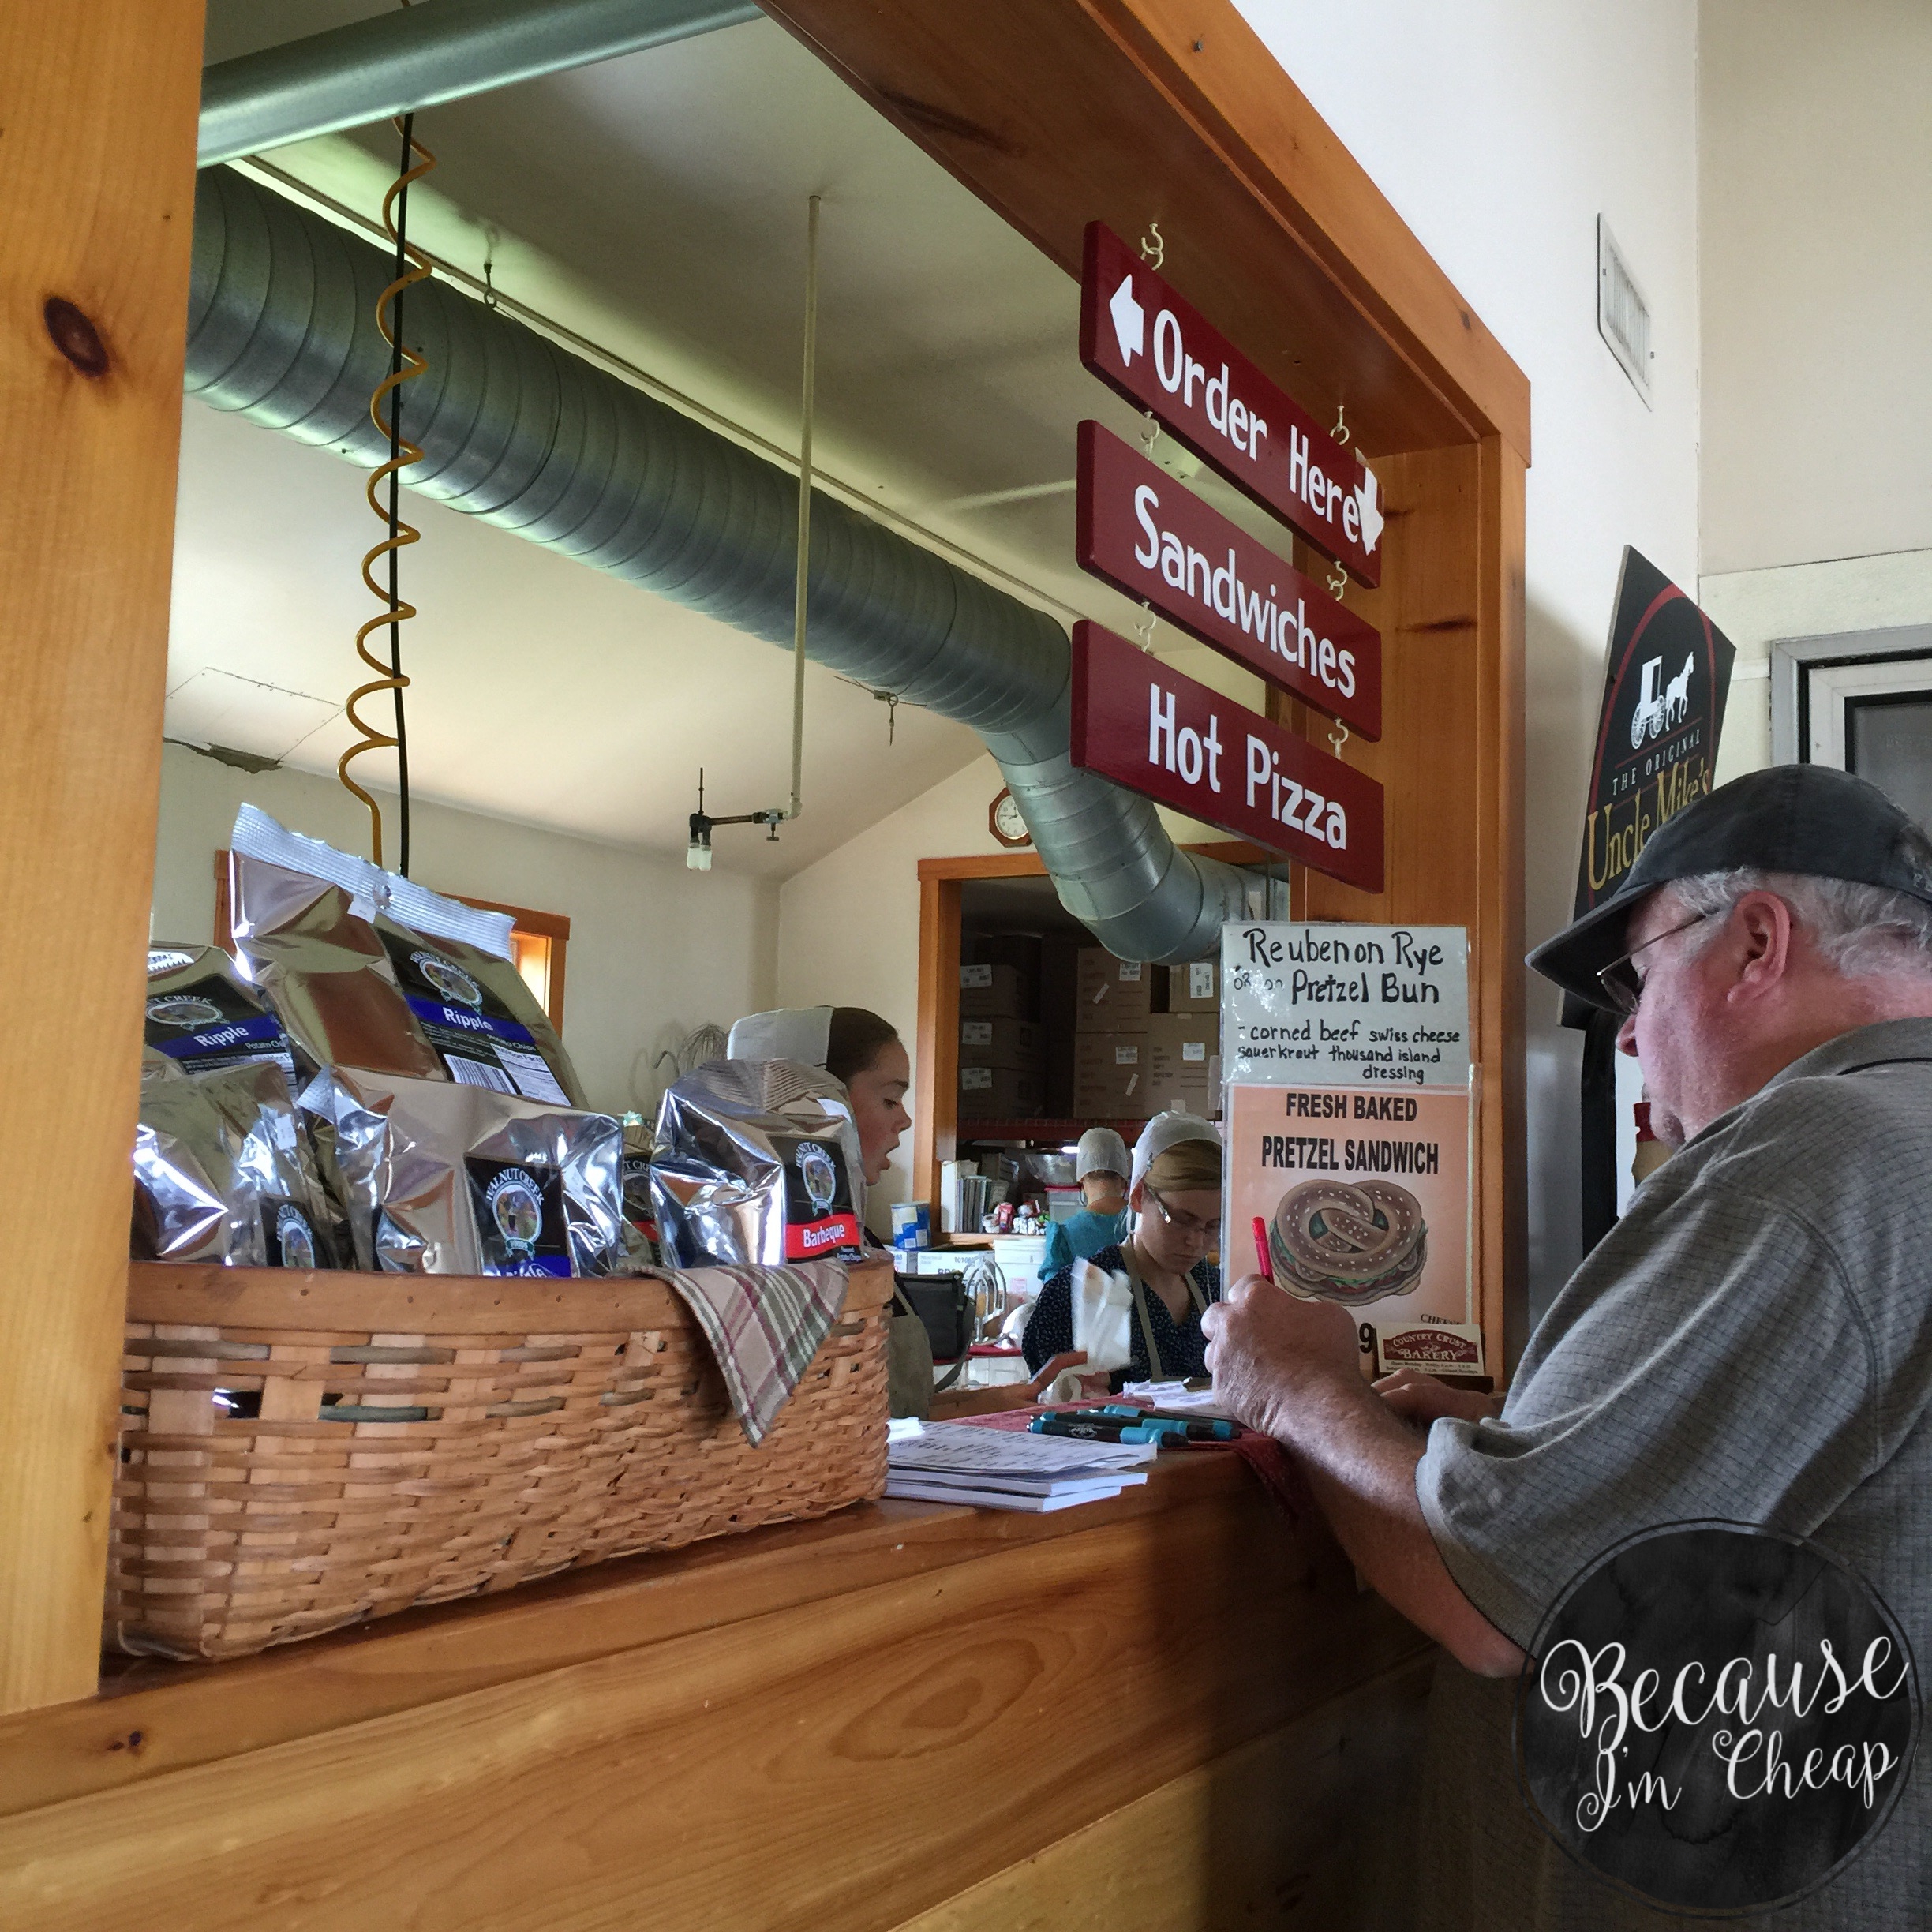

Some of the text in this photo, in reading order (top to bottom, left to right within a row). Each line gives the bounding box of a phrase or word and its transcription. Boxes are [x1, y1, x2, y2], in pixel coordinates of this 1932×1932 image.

[1153, 309, 1360, 544] Order Here
[1134, 485, 1355, 698] Sandwiches
[1148, 683, 1347, 850] Hot Pizza
[1612, 728, 1700, 796] THE ORIGINAL
[1588, 757, 1710, 891] Uncle Mike's
[1243, 928, 1443, 975] Reuben on Rye
[1292, 969, 1369, 1005] Pretzel
[1381, 972, 1440, 1004] Bun
[443, 1007, 493, 1032] Ripple
[1250, 1020, 1311, 1041] corned
[1320, 1019, 1361, 1042] beef
[1368, 1028, 1409, 1043] swiss
[1413, 1026, 1460, 1043] cheese
[193, 1025, 249, 1047] Ripple
[1237, 1045, 1440, 1063] sauerkraut thousand island
[1362, 1064, 1424, 1085] dressing
[1286, 1093, 1417, 1121] FRESH BAKED
[1262, 1136, 1439, 1174] PRETZEL SANDWICH
[485, 1167, 519, 1201] WALNUT
[803, 1223, 845, 1248] Barbeque
[1393, 1333, 1466, 1350] COUNTRY CRUST
[1400, 1348, 1458, 1361] BAKERY
